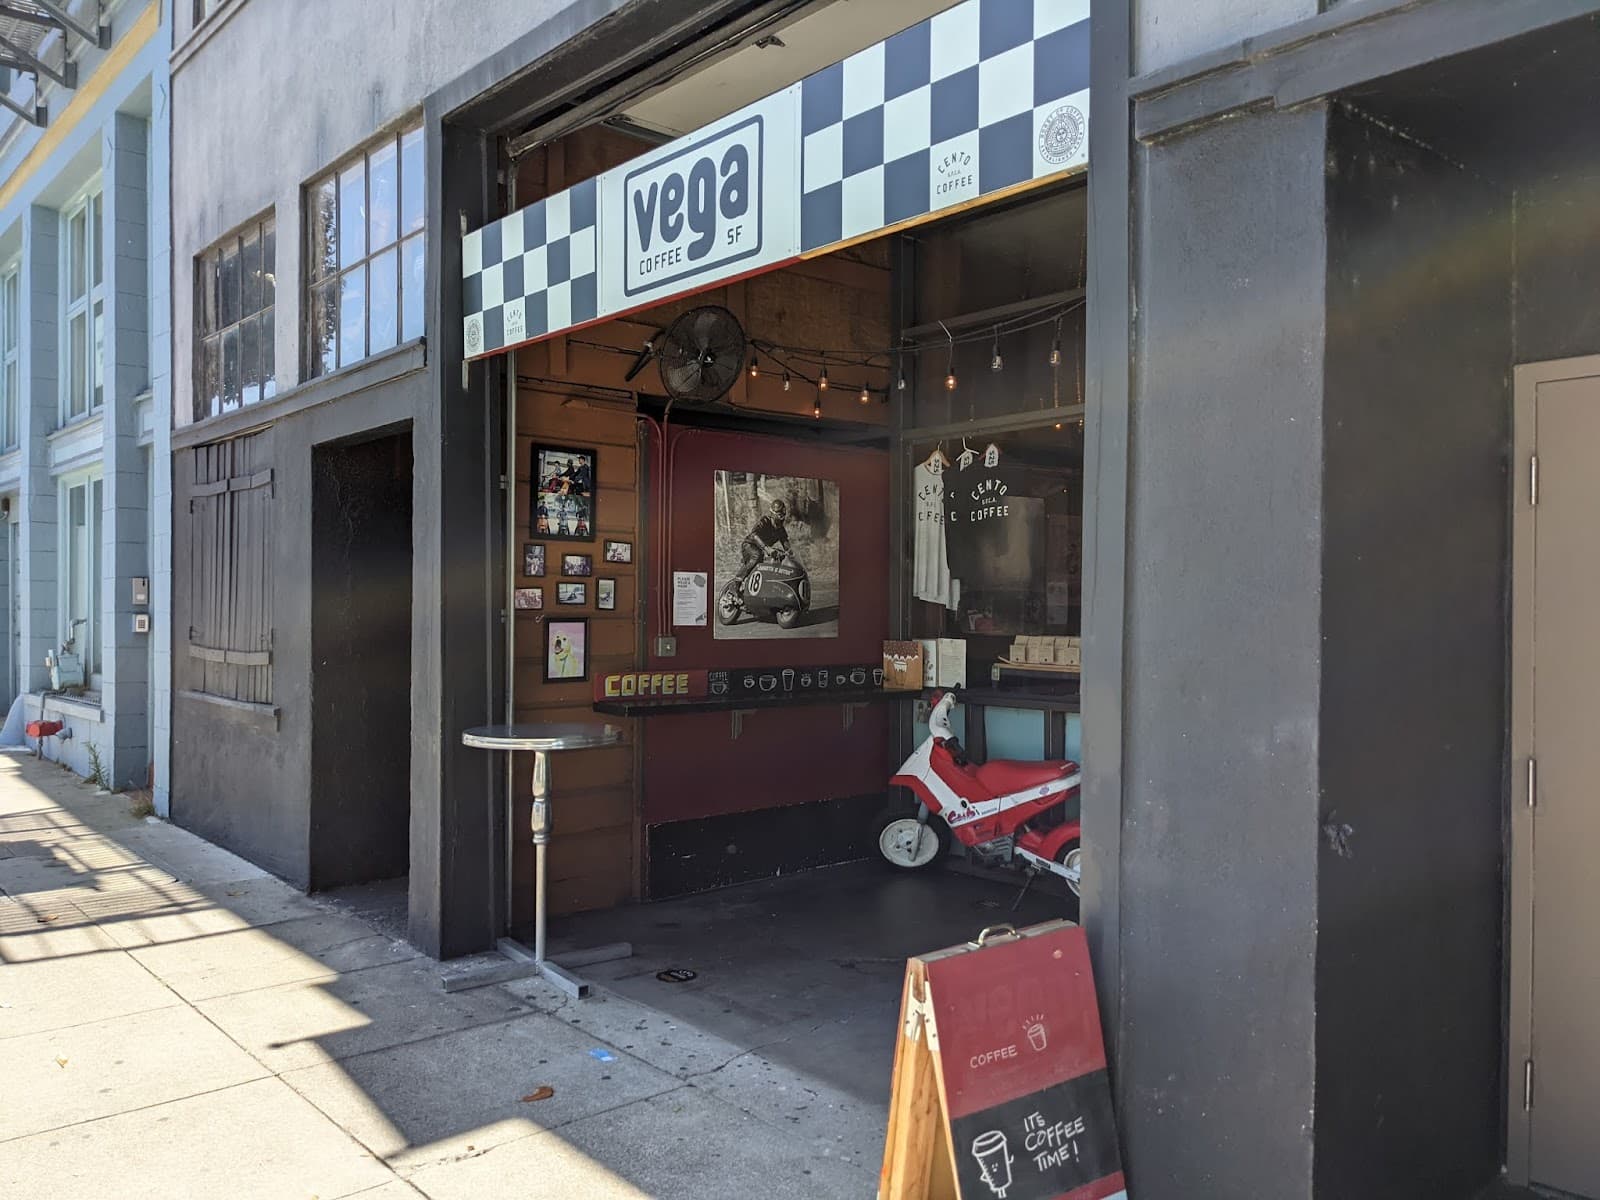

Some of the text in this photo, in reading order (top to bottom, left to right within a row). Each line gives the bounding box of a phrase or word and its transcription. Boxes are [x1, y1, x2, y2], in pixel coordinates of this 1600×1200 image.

[937, 151, 971, 174] CENTO
[936, 174, 973, 195] COFFEE
[633, 143, 749, 261] vega
[639, 225, 743, 275] COFFEE SF
[971, 479, 1008, 501] CENTO
[970, 505, 1009, 522] COFFEE
[604, 673, 689, 697] COFFEE
[970, 1045, 1018, 1068] COFFEE
[1023, 1112, 1045, 1132] ITS
[1024, 1116, 1086, 1151] COFFEE
